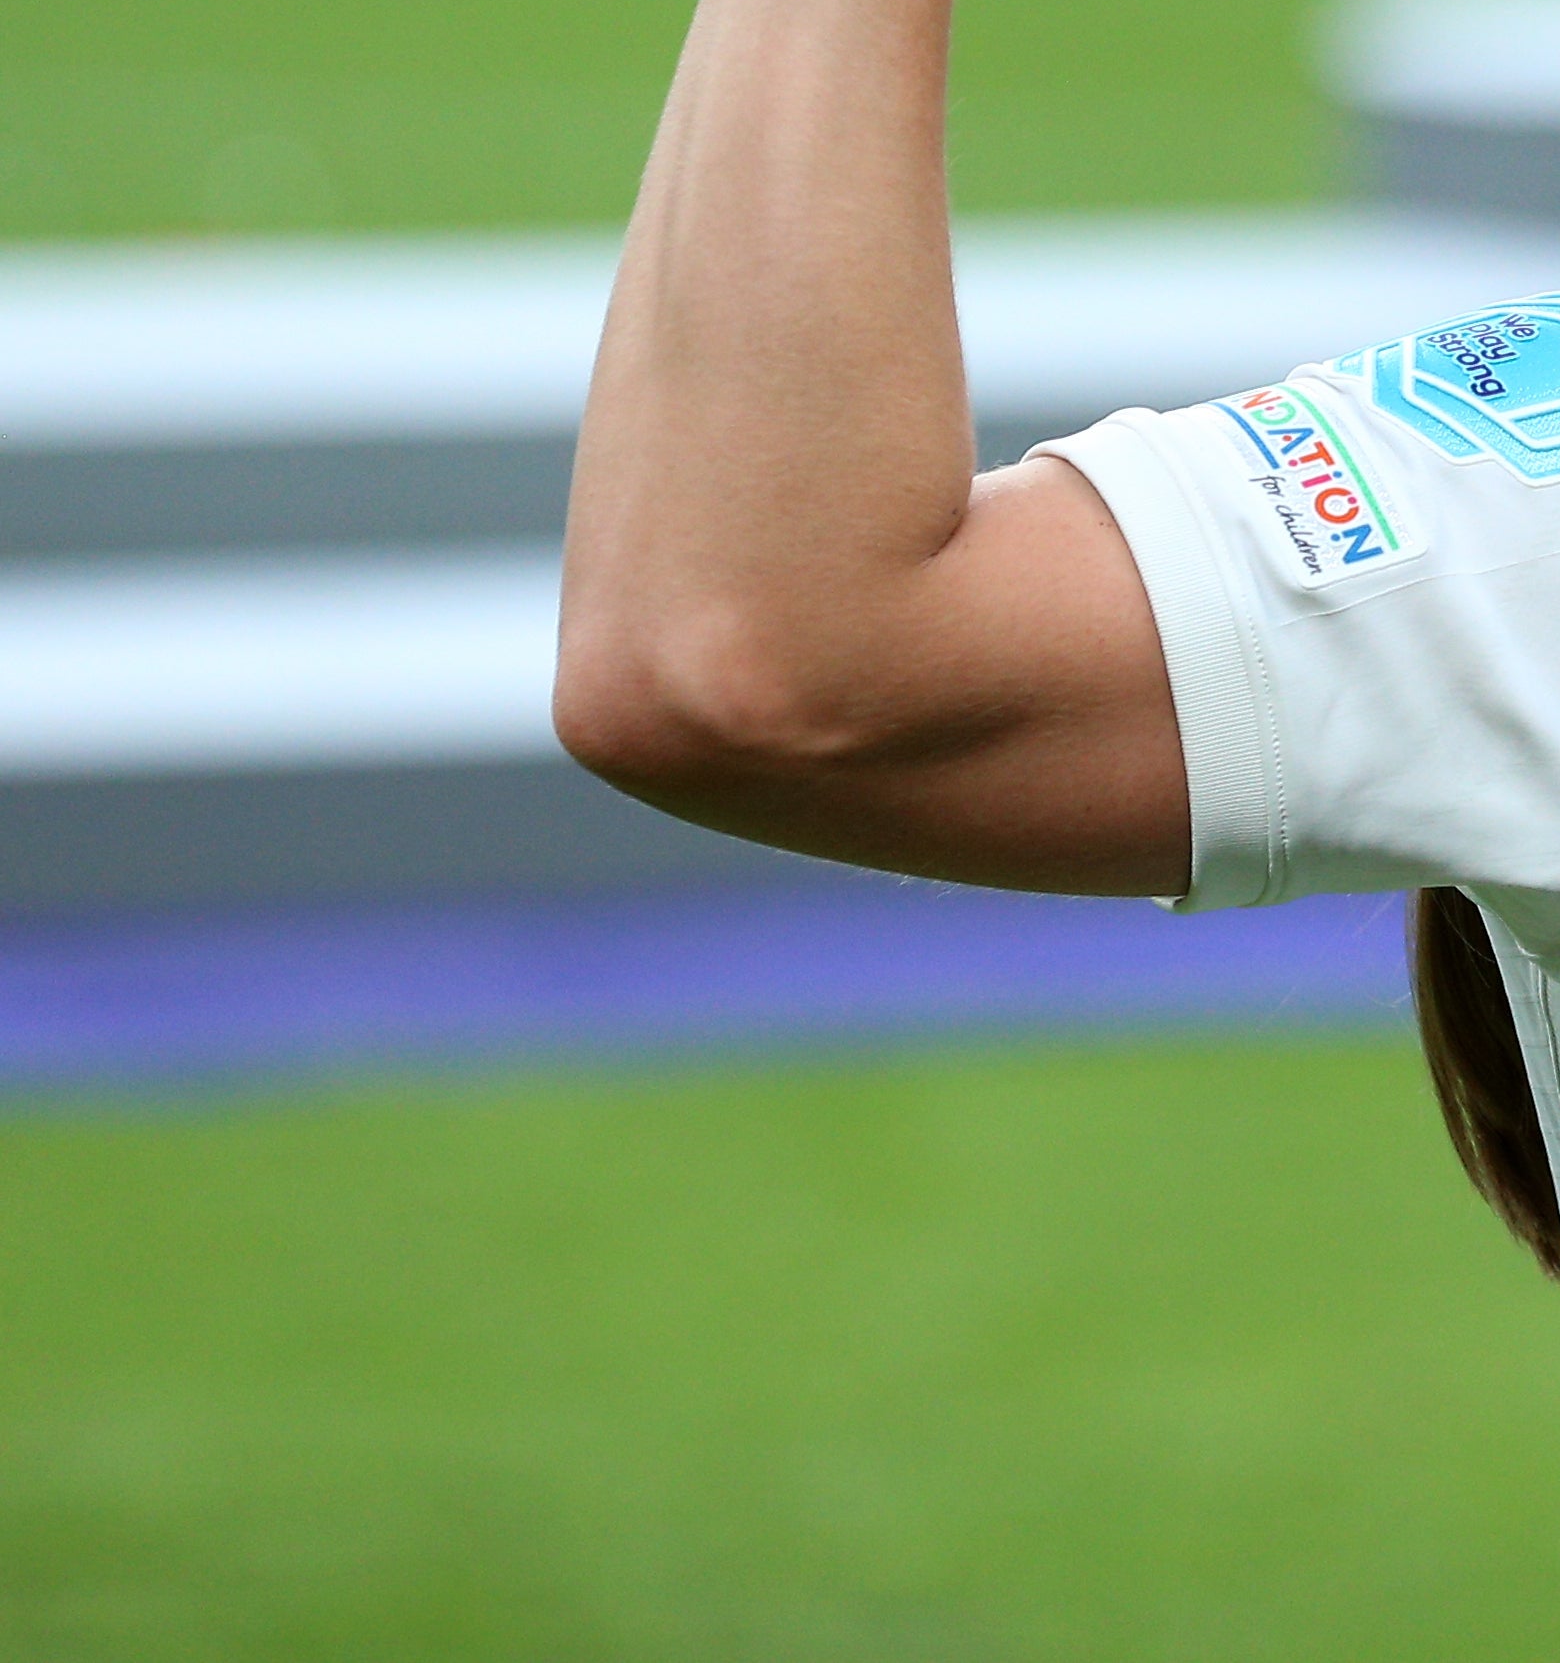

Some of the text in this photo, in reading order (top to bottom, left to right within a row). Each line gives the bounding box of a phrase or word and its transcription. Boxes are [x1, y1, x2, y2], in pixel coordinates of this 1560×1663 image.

[1500, 314, 1536, 338] We
[1249, 475, 1323, 576] for children
